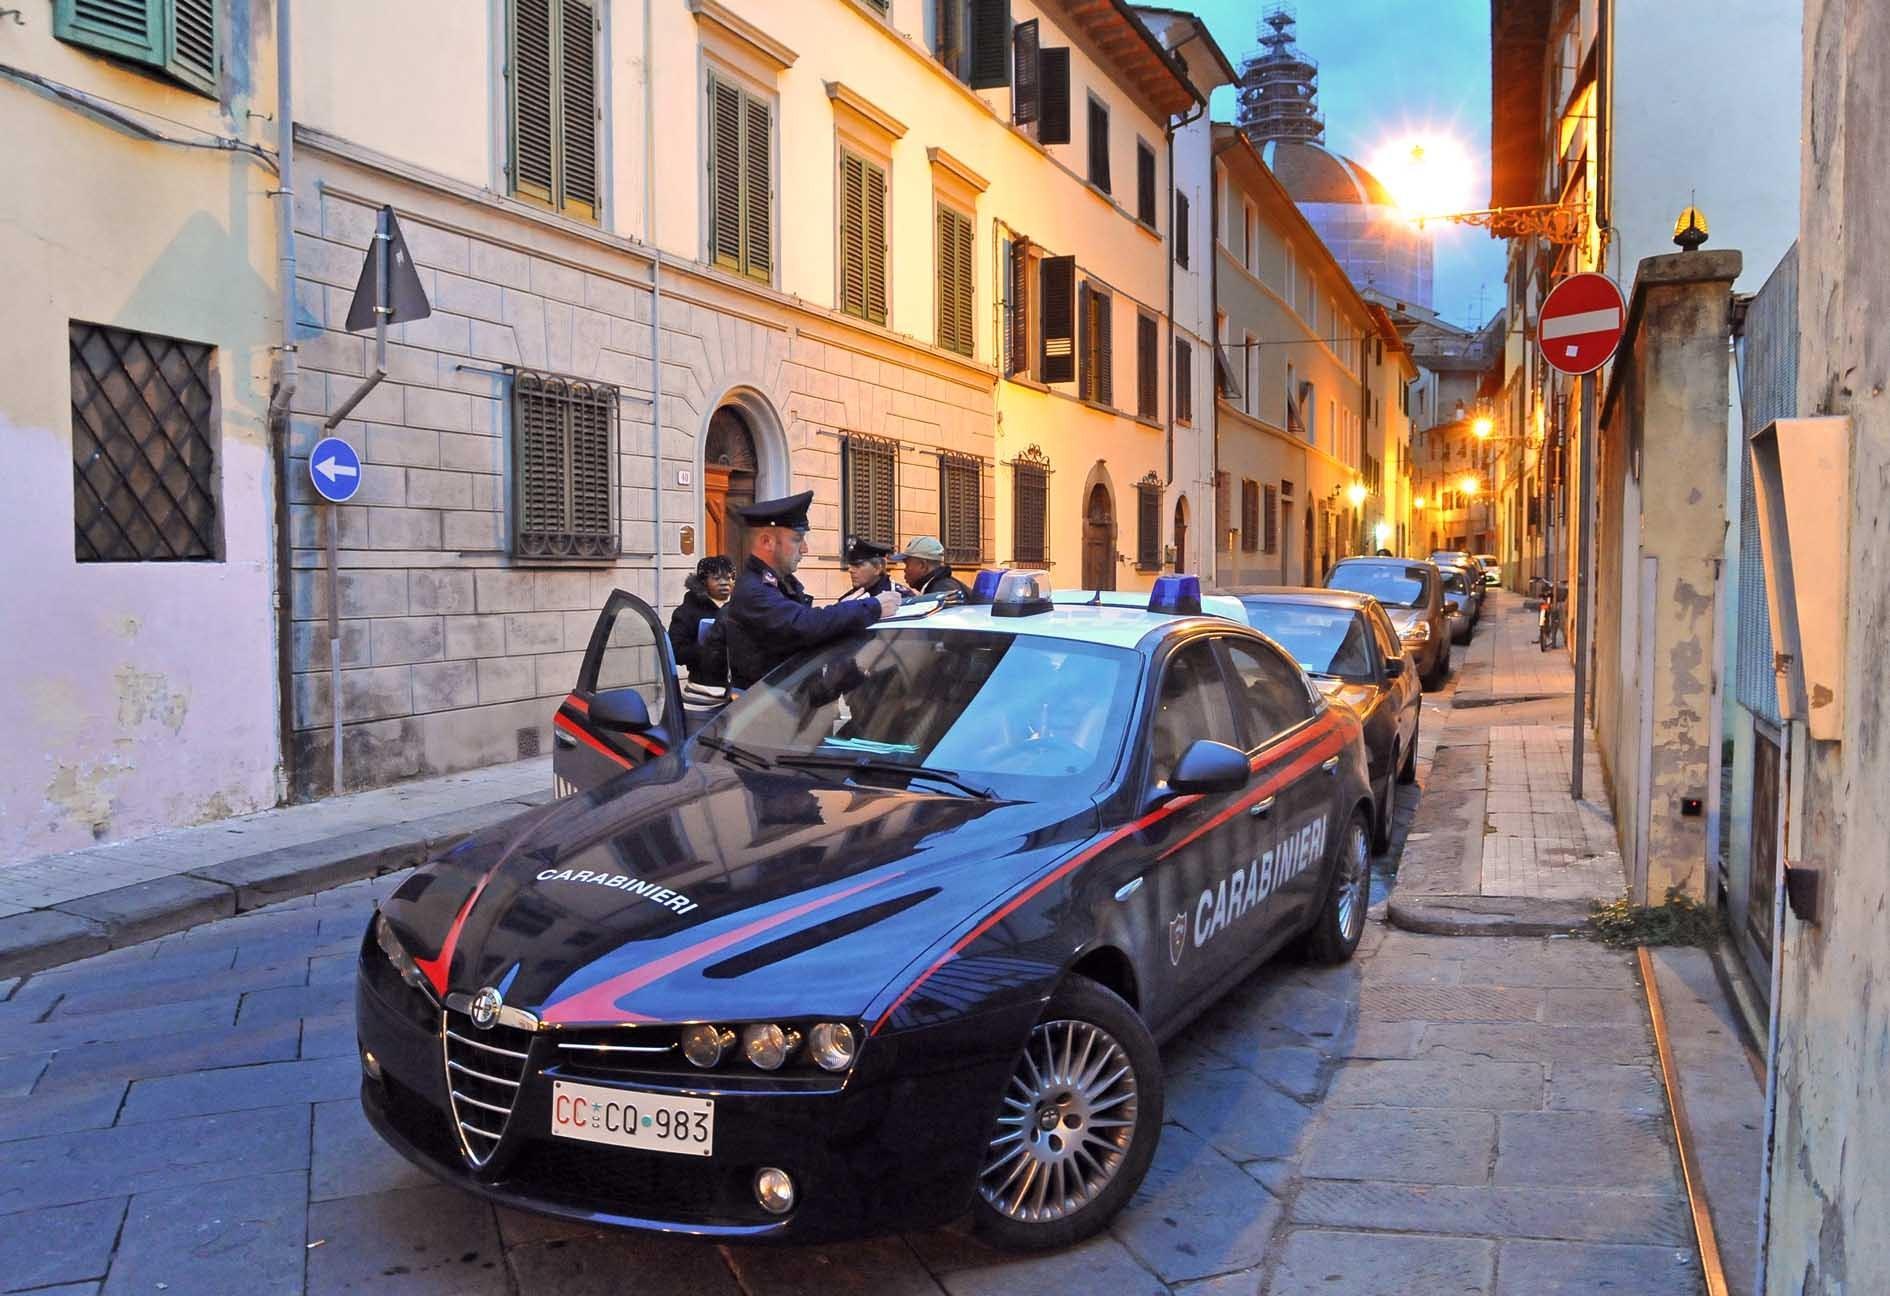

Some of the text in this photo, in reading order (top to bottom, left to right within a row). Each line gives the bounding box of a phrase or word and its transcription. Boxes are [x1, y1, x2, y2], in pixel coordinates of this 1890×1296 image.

[536, 869, 698, 915] CARABINIERI
[1194, 813, 1328, 948] CARABINIERI
[556, 1095, 709, 1143] CC CQ 983
